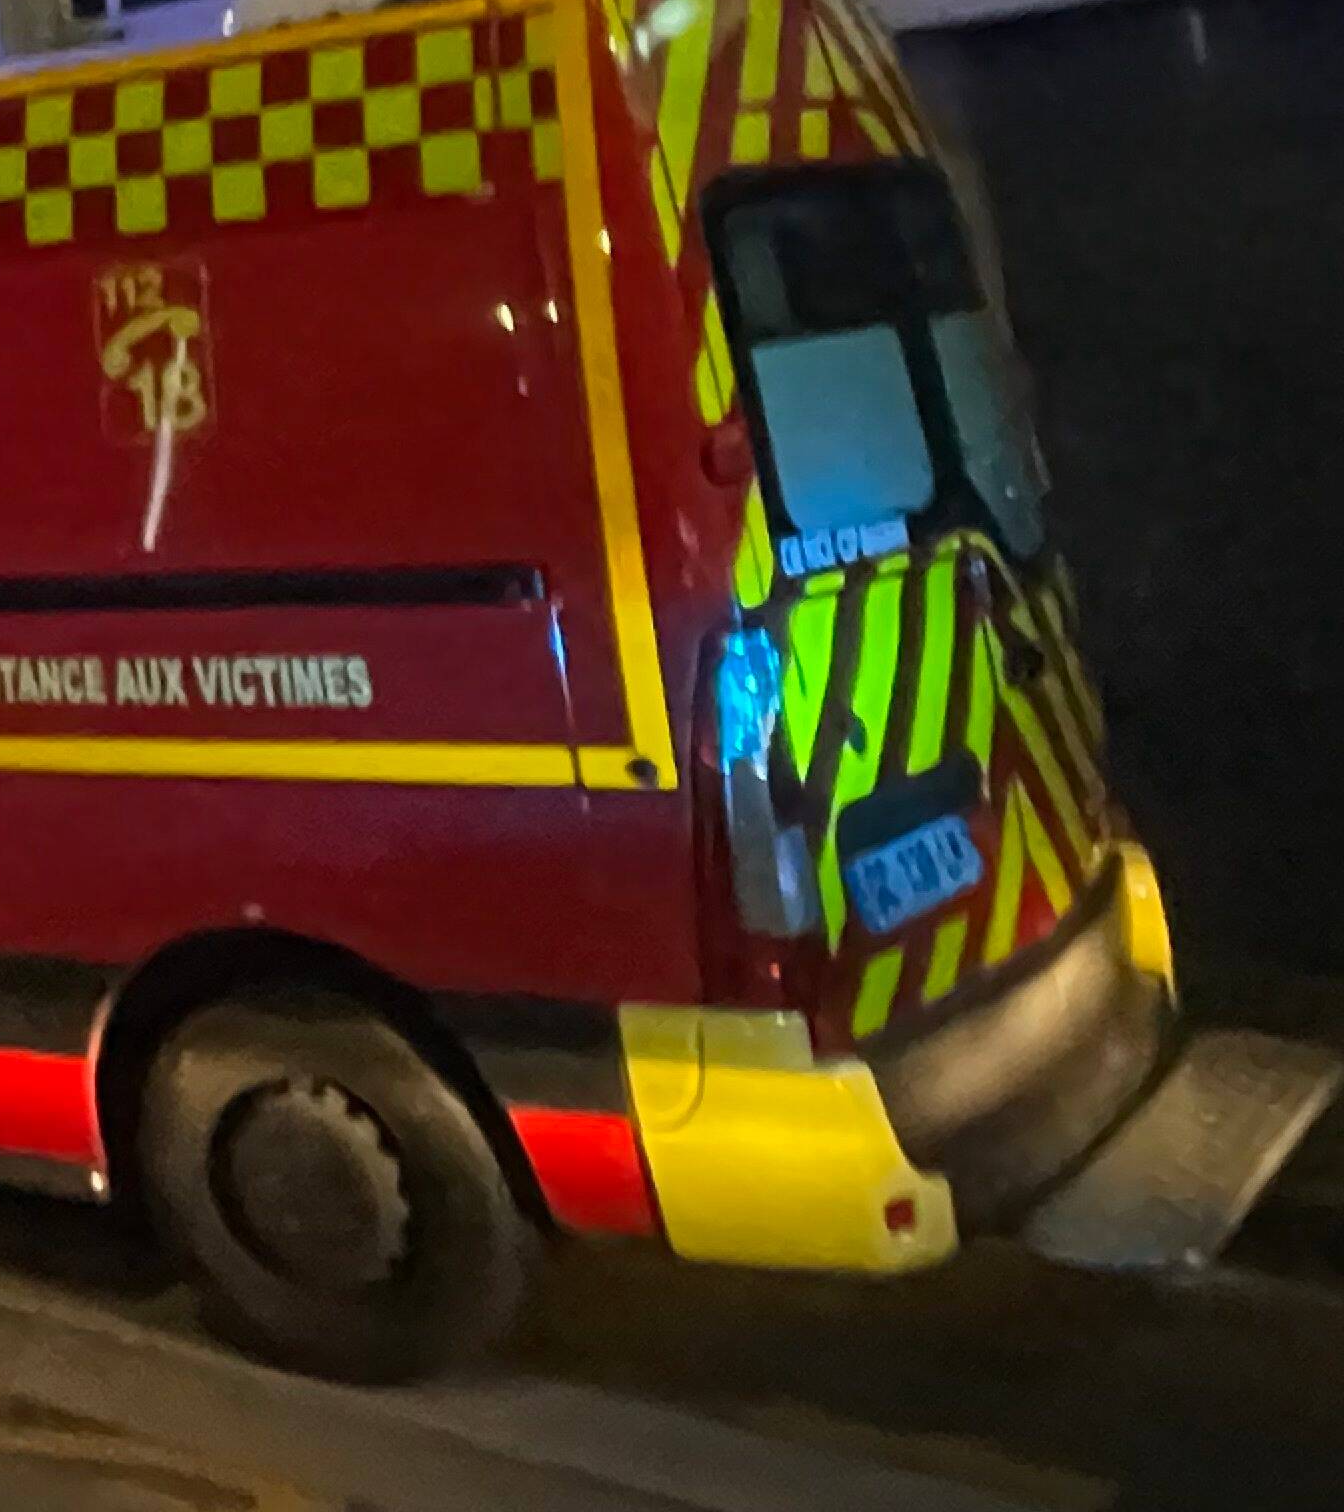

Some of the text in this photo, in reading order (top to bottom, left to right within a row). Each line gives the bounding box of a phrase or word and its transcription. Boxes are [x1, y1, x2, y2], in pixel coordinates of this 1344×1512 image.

[96, 264, 165, 312] 112
[129, 360, 209, 432] 18
[116, 656, 190, 707] AUX
[192, 656, 373, 707] VICTIMES
